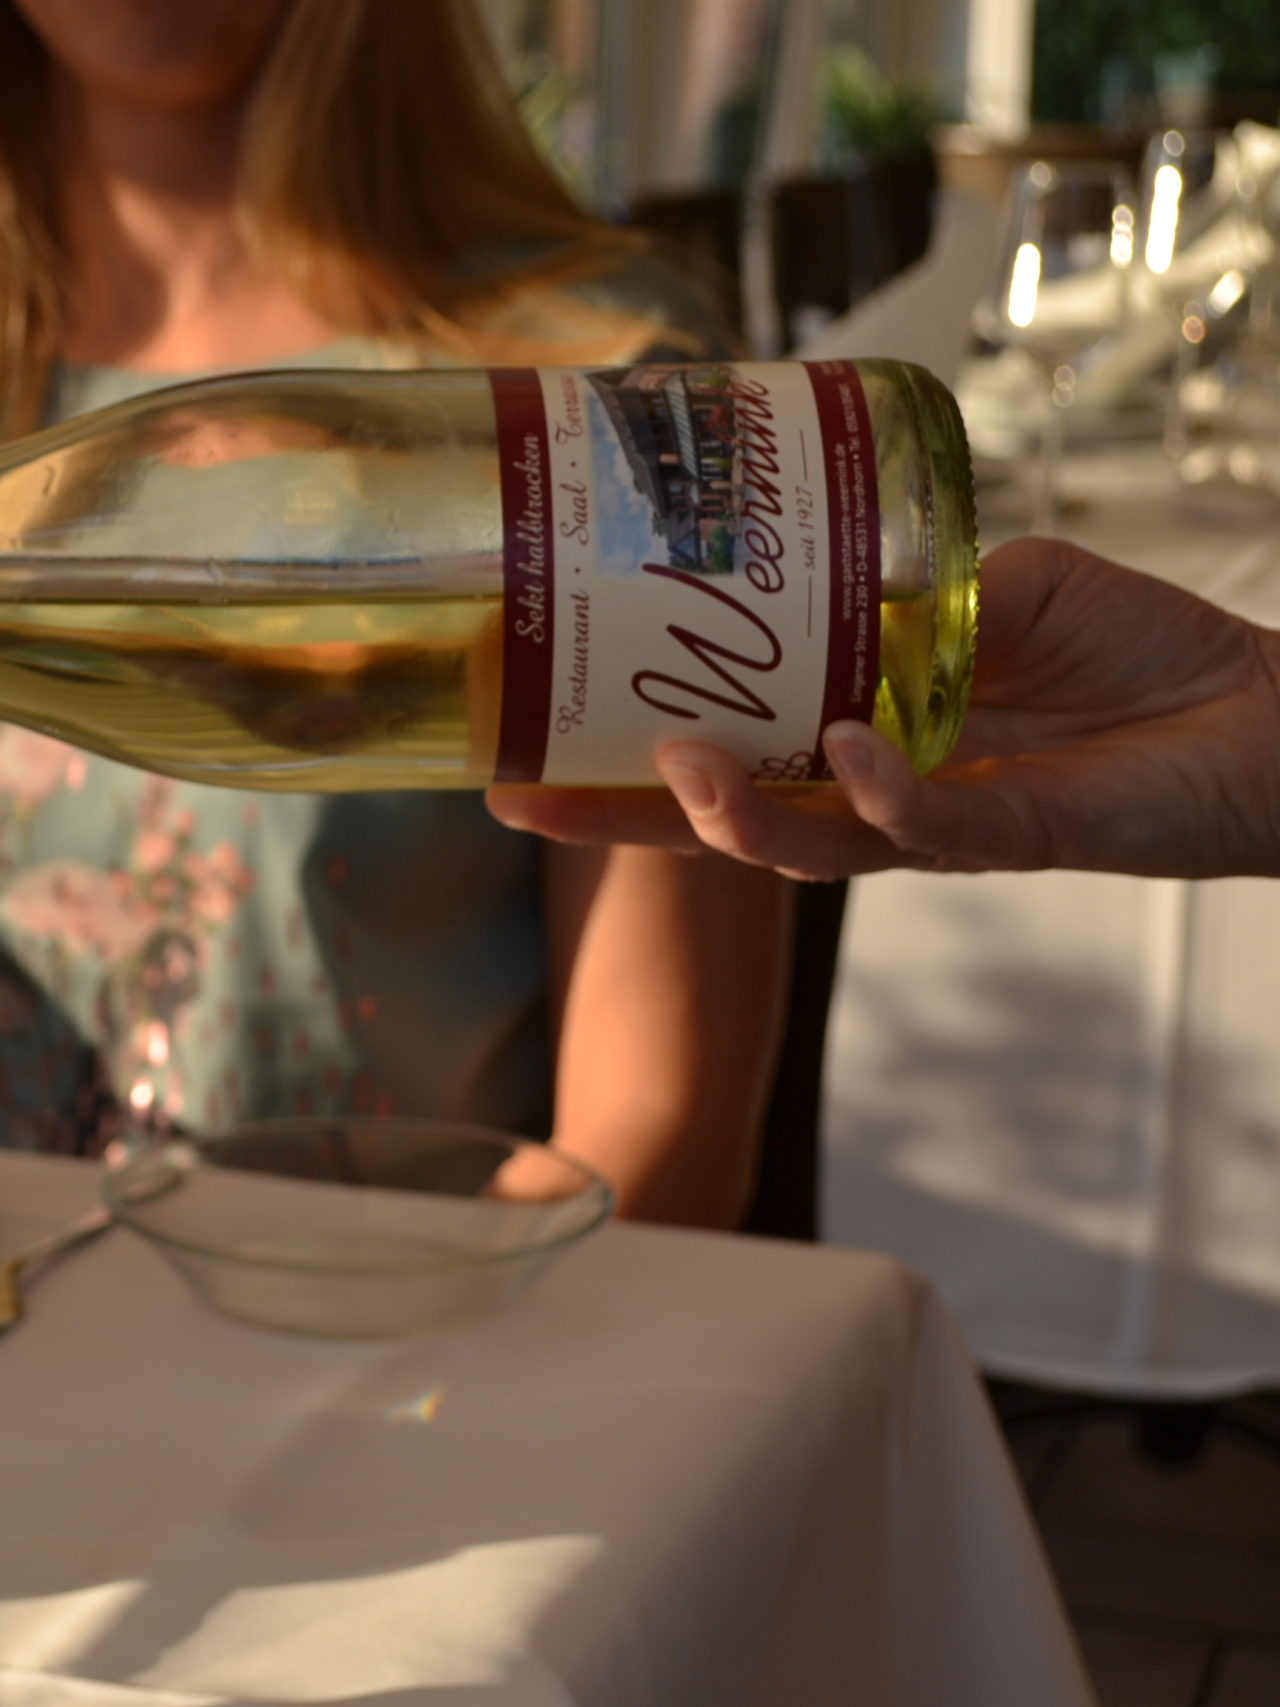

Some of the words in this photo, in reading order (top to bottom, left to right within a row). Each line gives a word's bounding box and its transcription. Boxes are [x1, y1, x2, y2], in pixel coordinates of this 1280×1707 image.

[848, 436, 860, 452] Tel.
[513, 432, 544, 576] halbtrocken
[560, 480, 589, 545] Saal
[796, 485, 815, 530] 1927
[853, 461, 866, 518] Nordhorn
[631, 377, 785, 722] Weernink
[800, 535, 817, 571] seit
[855, 521, 869, 573] D-48531
[515, 579, 545, 644] Sekt
[856, 585, 868, 609] 230
[855, 612, 867, 652] Strasse
[556, 588, 590, 736] Restaurant
[852, 654, 865, 702] Lingener
